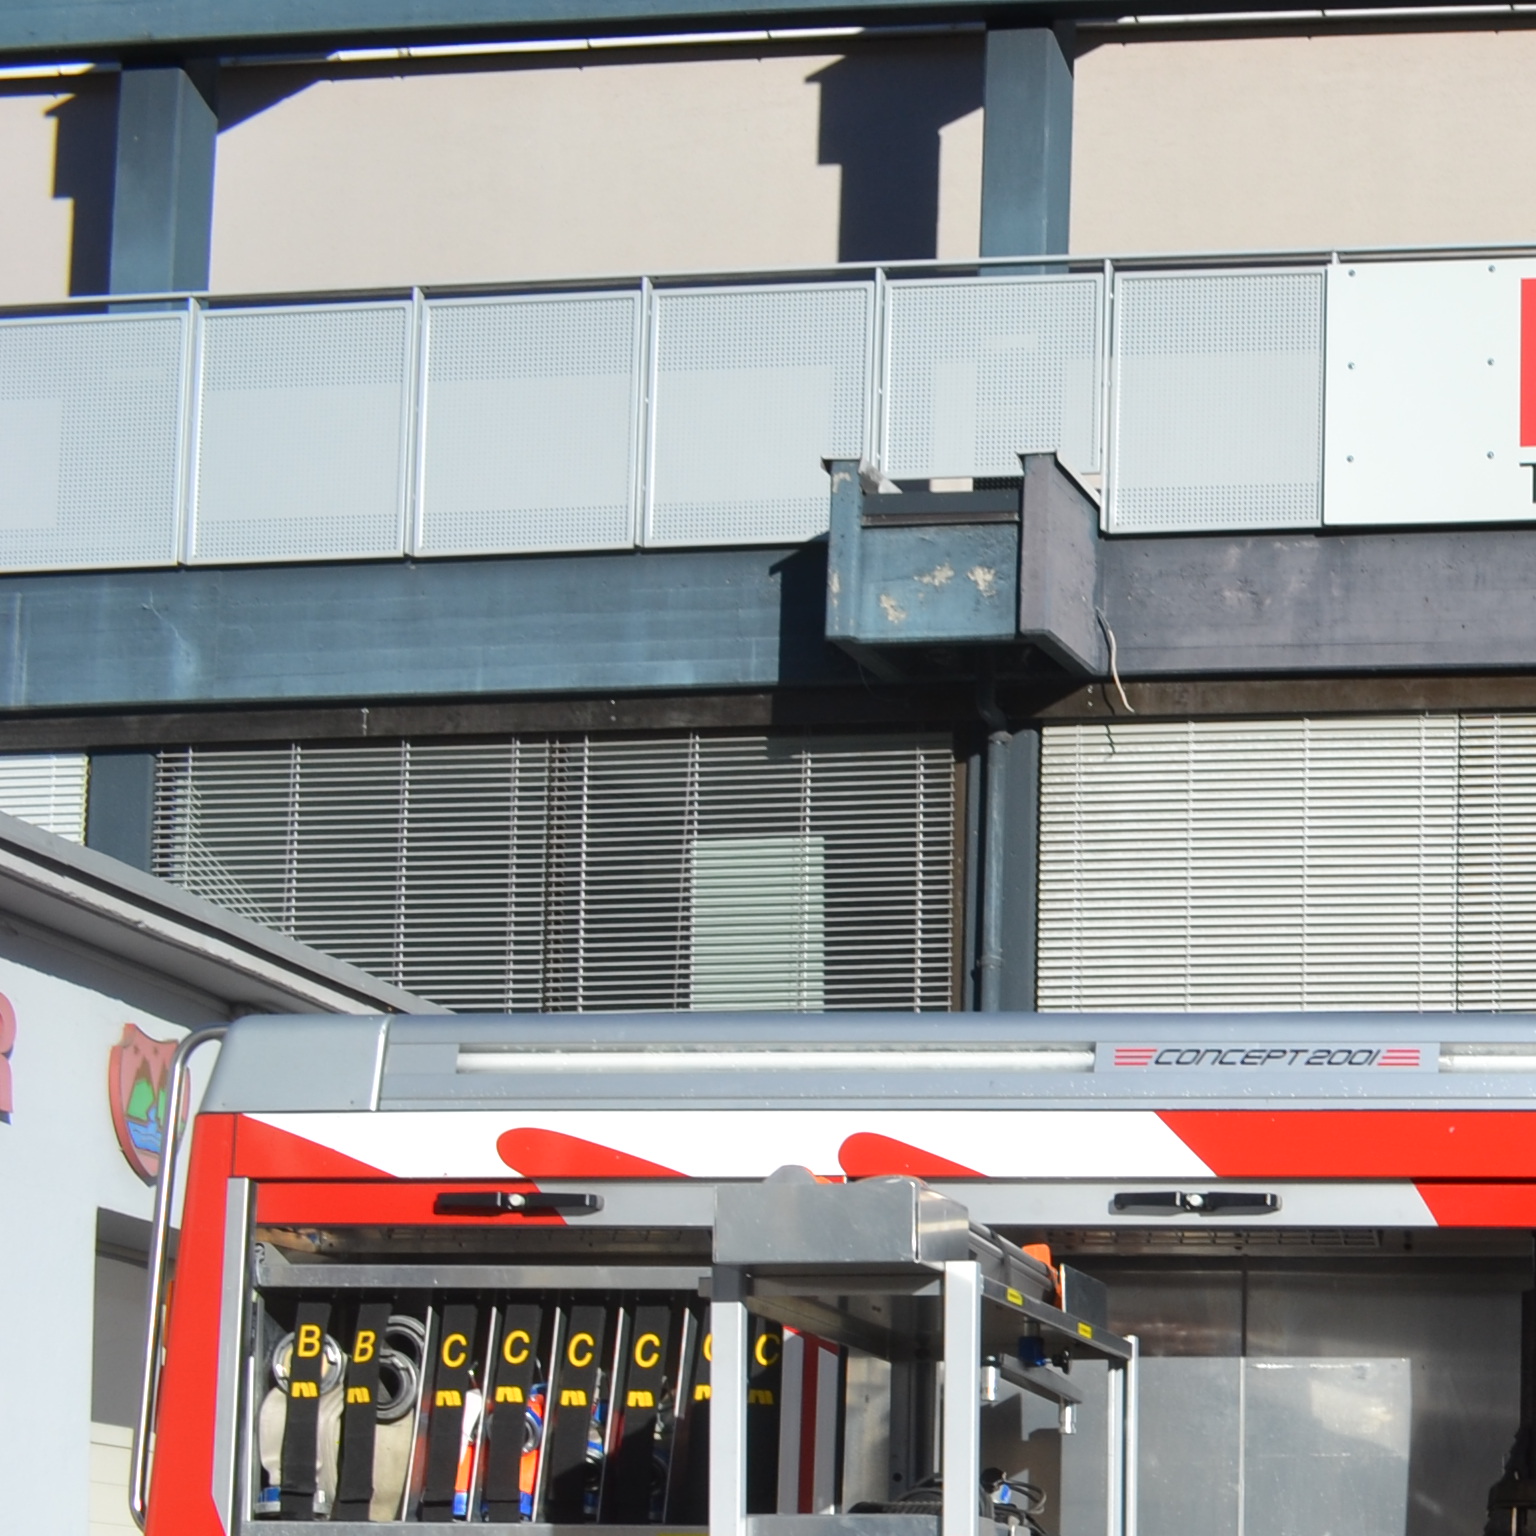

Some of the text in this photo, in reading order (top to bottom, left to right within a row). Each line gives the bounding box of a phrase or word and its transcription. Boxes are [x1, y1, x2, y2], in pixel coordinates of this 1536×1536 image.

[1154, 1048, 1309, 1066] CONCEPT
[296, 1322, 322, 1360] B
[352, 1328, 377, 1365] B
[441, 1332, 468, 1370] C
[502, 1328, 532, 1366] C
[567, 1332, 596, 1369] C
[633, 1331, 662, 1370] C
